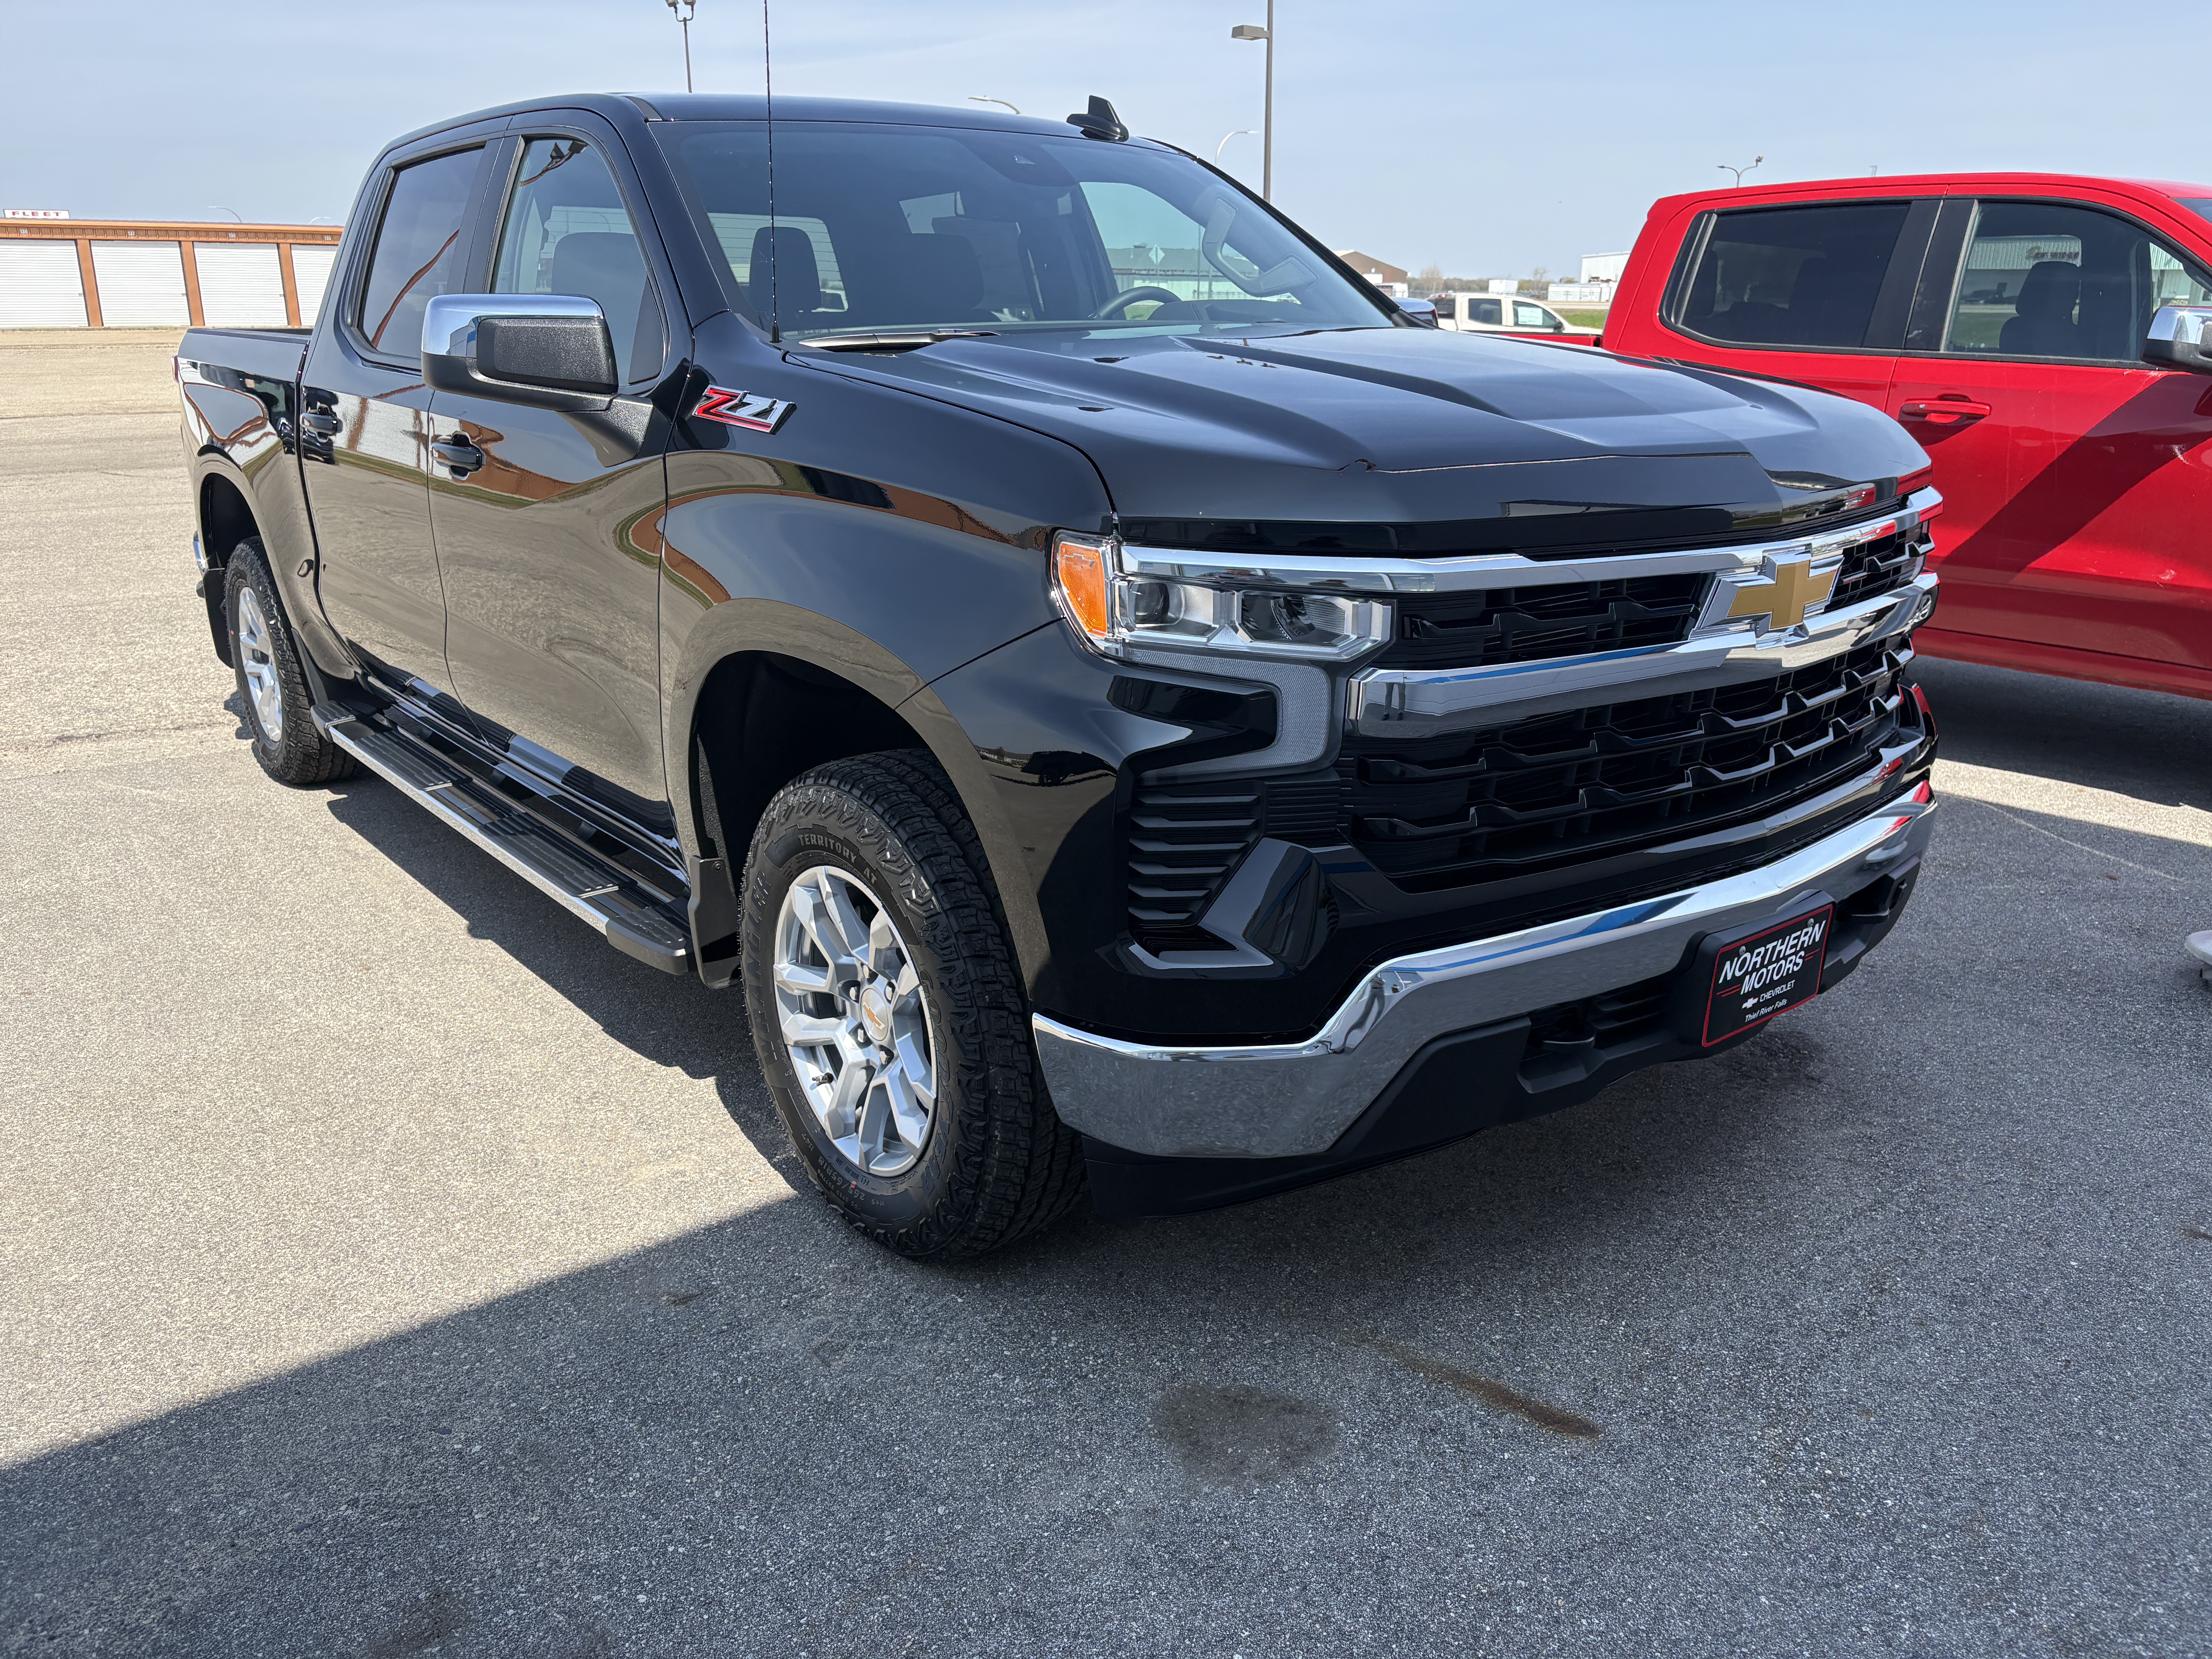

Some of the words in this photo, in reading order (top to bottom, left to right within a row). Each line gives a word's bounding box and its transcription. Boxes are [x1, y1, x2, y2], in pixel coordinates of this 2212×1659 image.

[692, 384, 797, 435] Z71
[798, 834, 857, 864] TERRITORY
[864, 867, 877, 885] AT
[747, 869, 778, 1066] WRANGLER
[1718, 920, 1826, 984] NORTHERN
[1740, 950, 1805, 995] MOTORS
[1744, 1011, 1760, 1022] Thief
[1759, 1005, 1773, 1017] River
[1774, 998, 1788, 1009] Falls
[1760, 980, 1795, 1002] CHEVROLET
[920, 969, 953, 1197] GOODYEAR
[817, 1156, 866, 1200] 265/65R18
